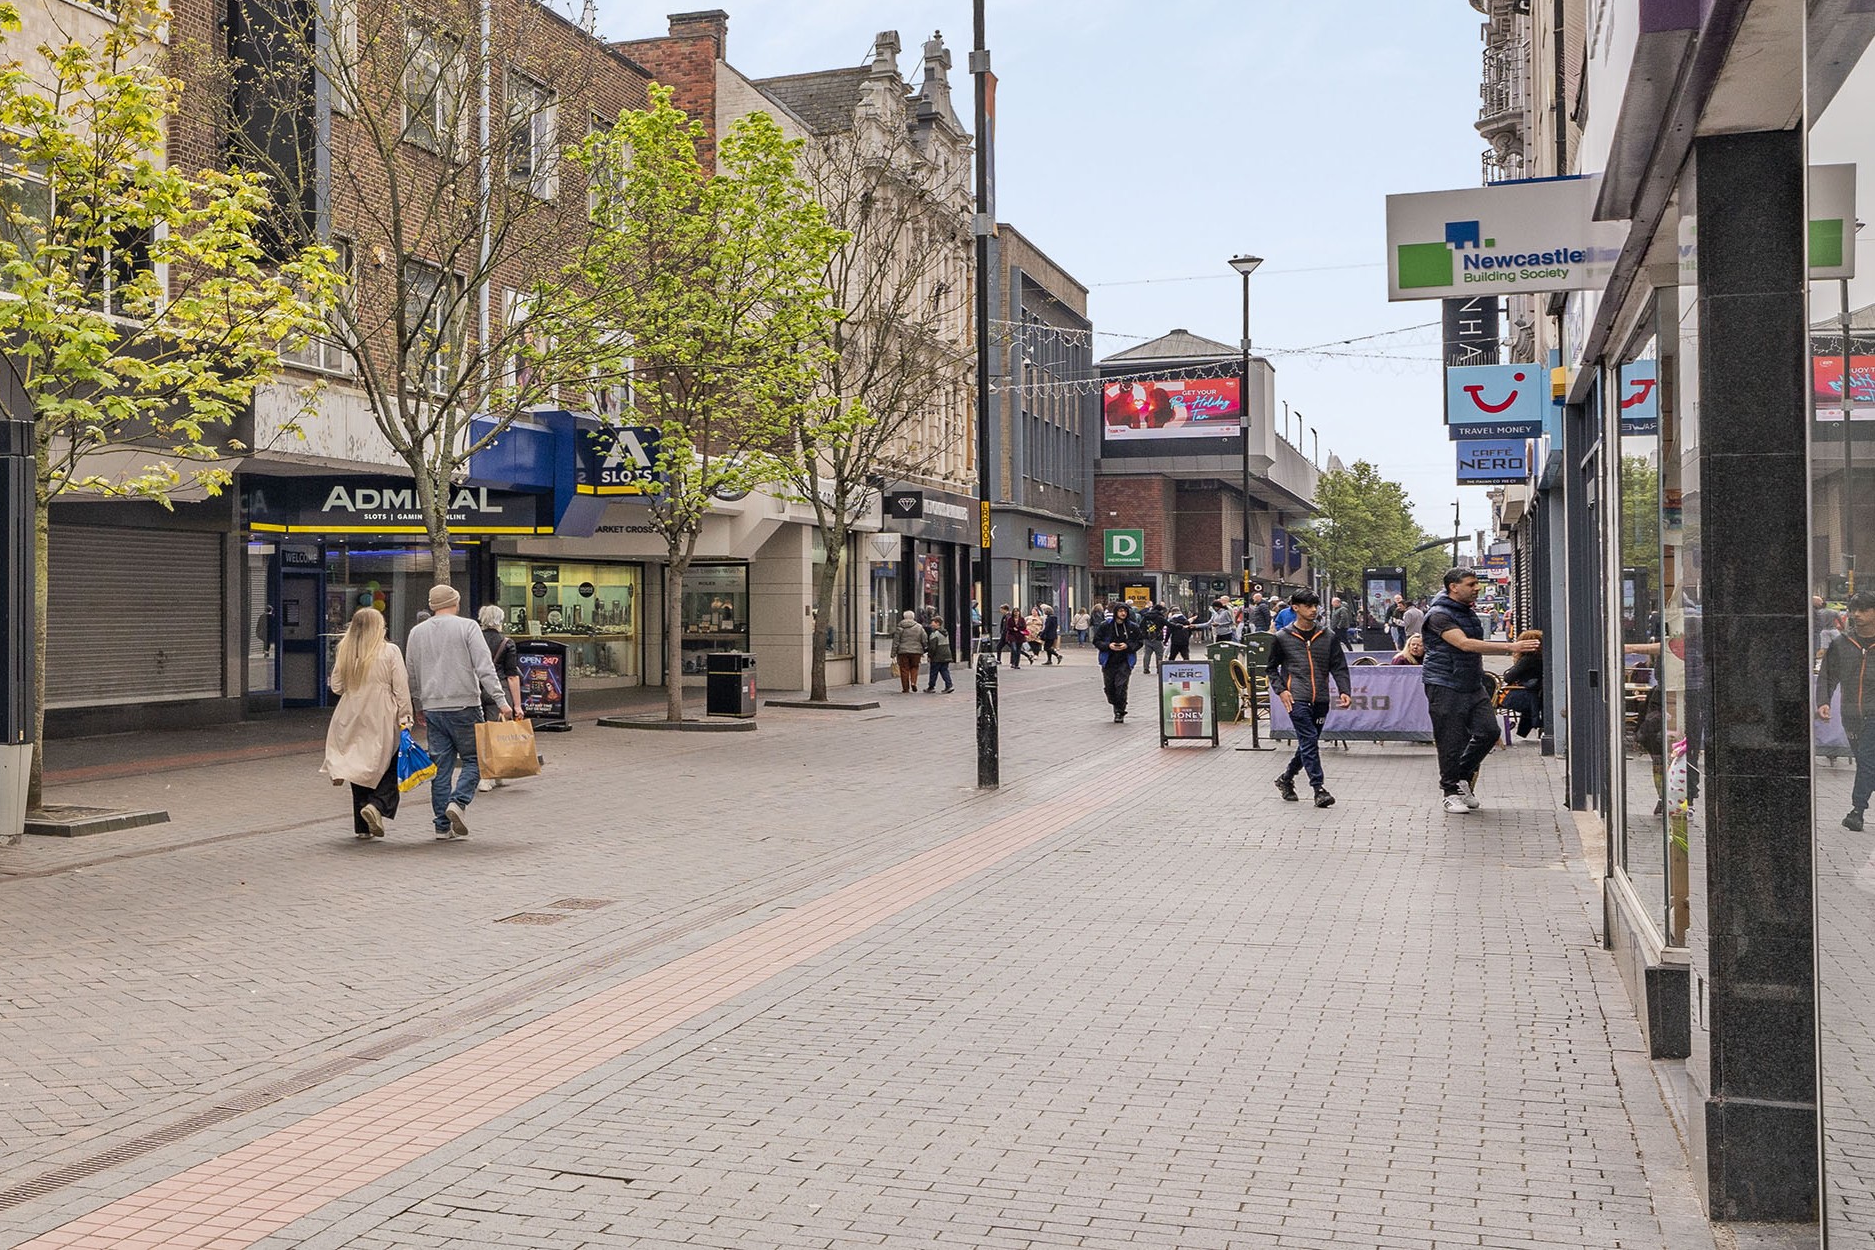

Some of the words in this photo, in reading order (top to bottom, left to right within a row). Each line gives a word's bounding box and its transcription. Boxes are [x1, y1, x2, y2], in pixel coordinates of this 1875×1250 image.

[1463, 247, 1585, 270] Newcastle
[1463, 270, 1516, 283] Building
[1520, 267, 1569, 281] Society
[1169, 395, 1231, 409] Pre-Holiday
[1191, 409, 1210, 422] Tan
[1459, 427, 1494, 436] TRAVEL
[1497, 425, 1532, 434] MONEY
[602, 430, 652, 468] A
[1472, 446, 1513, 457] CAFFÈ
[1460, 458, 1523, 470] NERO
[601, 469, 653, 483] SLOTS
[321, 485, 503, 513] ADMIAL
[625, 525, 653, 533] CROSS
[1113, 535, 1137, 556] D
[285, 553, 318, 564] WELCOME
[519, 656, 541, 664] OPEN
[1331, 695, 1390, 711] ERO
